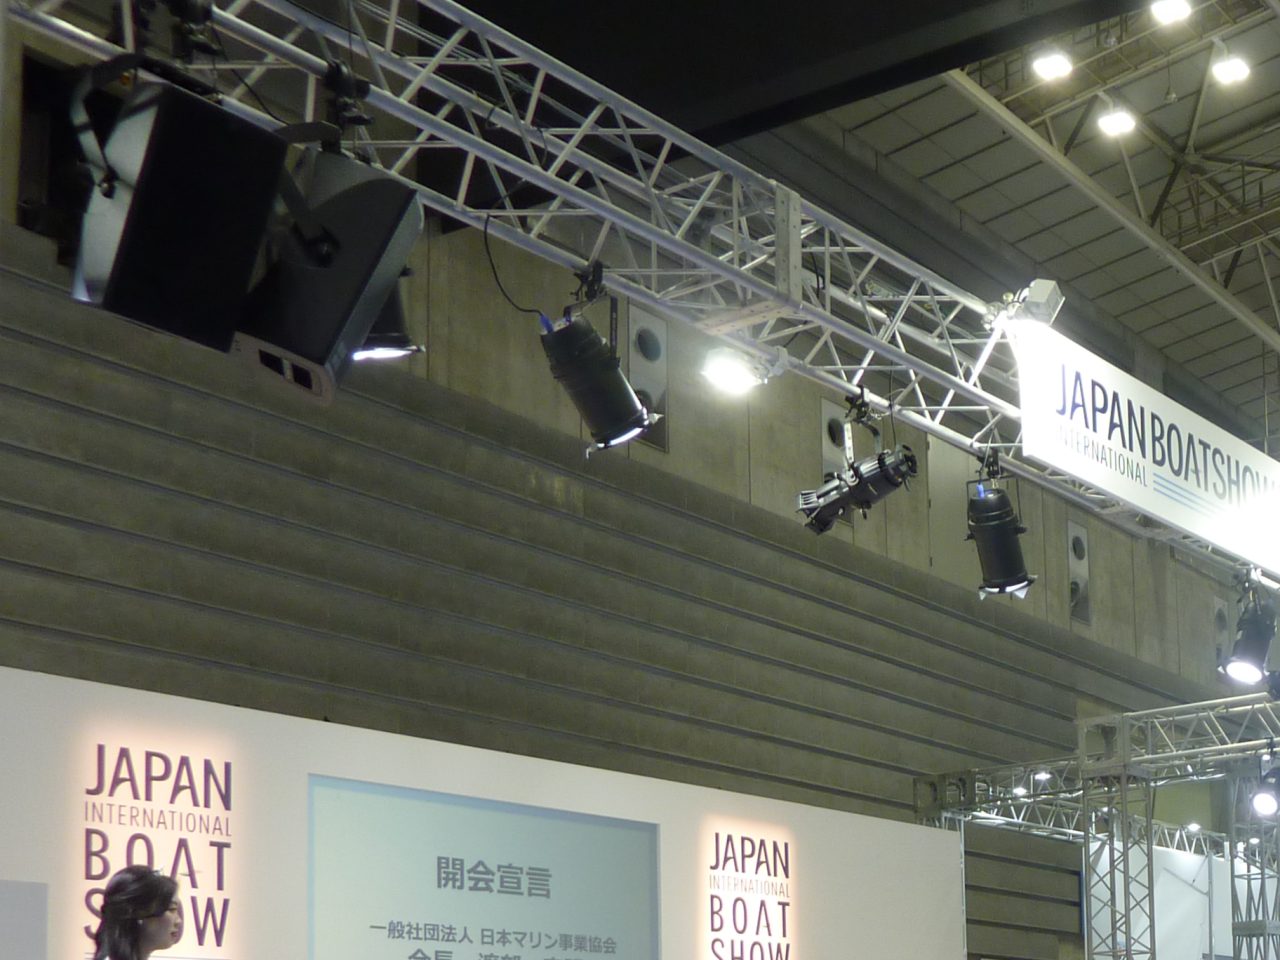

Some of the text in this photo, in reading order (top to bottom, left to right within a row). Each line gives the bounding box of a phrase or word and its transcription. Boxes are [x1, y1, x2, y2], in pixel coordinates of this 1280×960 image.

[1056, 424, 1147, 487] NTERNATIONAL
[85, 743, 232, 811] JAPAN
[85, 801, 232, 837] INTERNATIONAL
[85, 828, 231, 891] BOAT
[437, 856, 552, 899] 開会宣言
[710, 832, 789, 879] JAPAN
[709, 874, 790, 898] INTERNATIONAL
[84, 888, 230, 947] SW
[370, 920, 617, 954] 一般社団法人 日本マリン事業協会
[711, 895, 789, 938] BOAT
